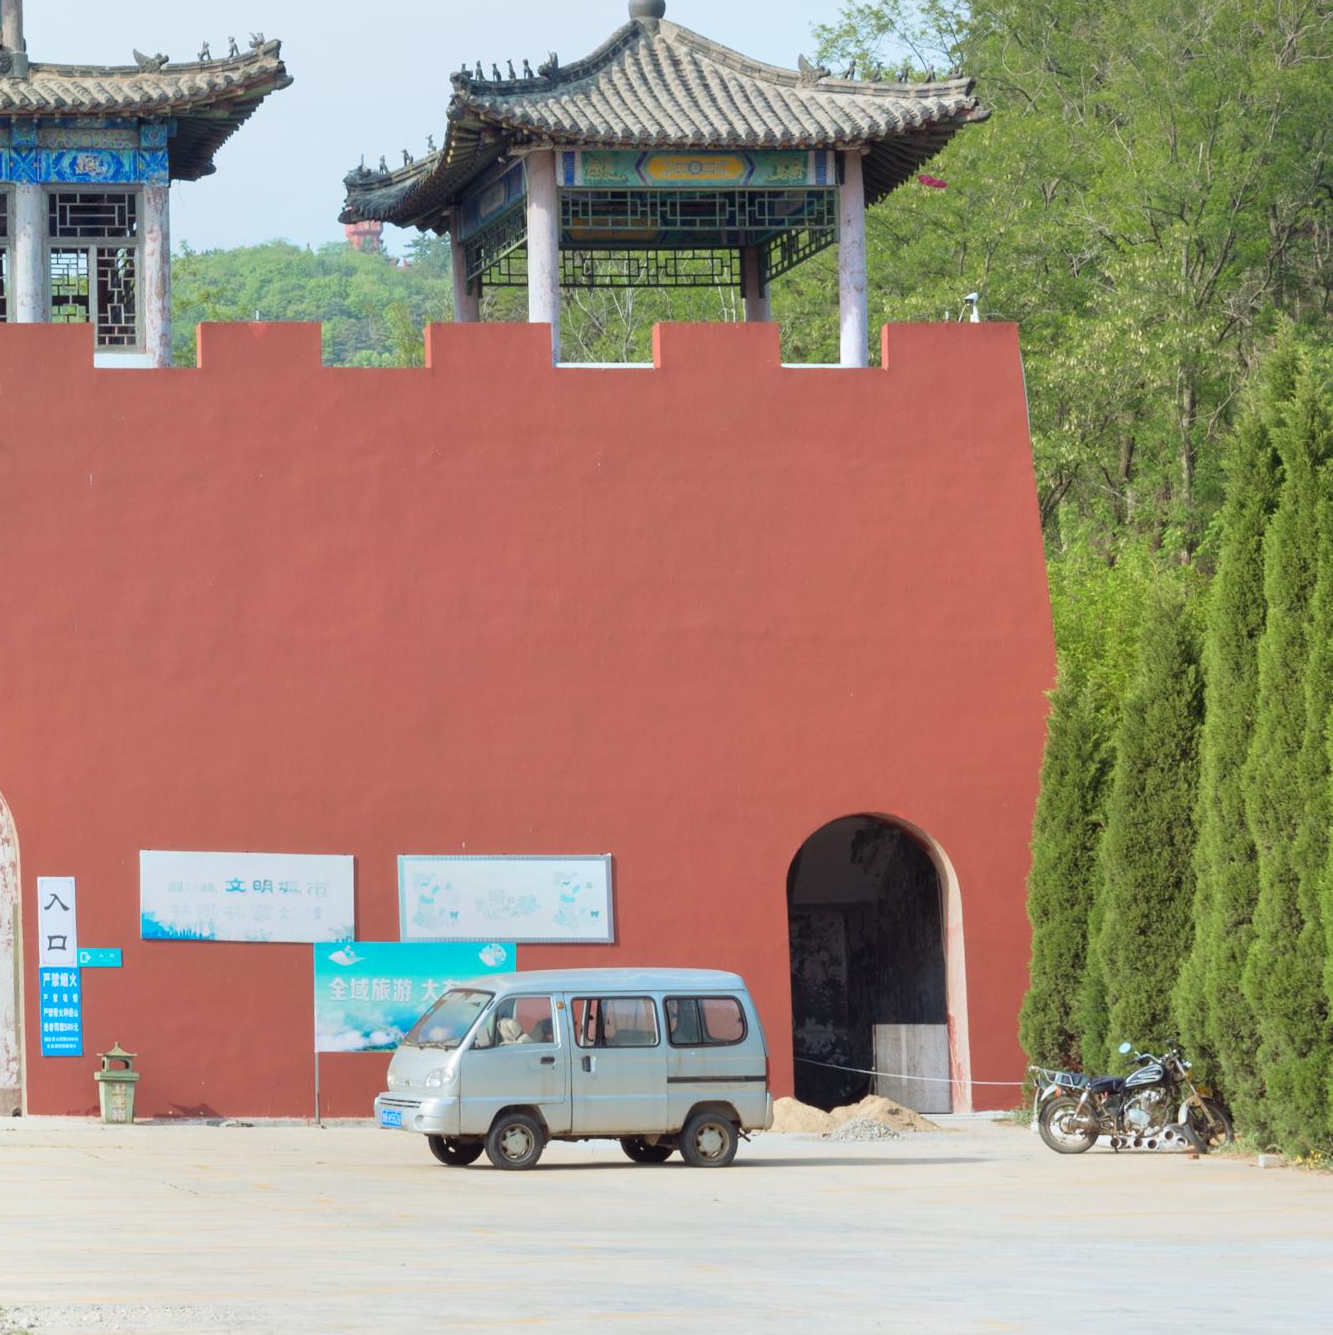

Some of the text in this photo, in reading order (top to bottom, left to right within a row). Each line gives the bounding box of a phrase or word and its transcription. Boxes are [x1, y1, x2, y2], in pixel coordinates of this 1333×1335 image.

[169, 878, 329, 897] 文明城市
[44, 893, 70, 951] 入口
[329, 977, 412, 1002] 全域旅游
